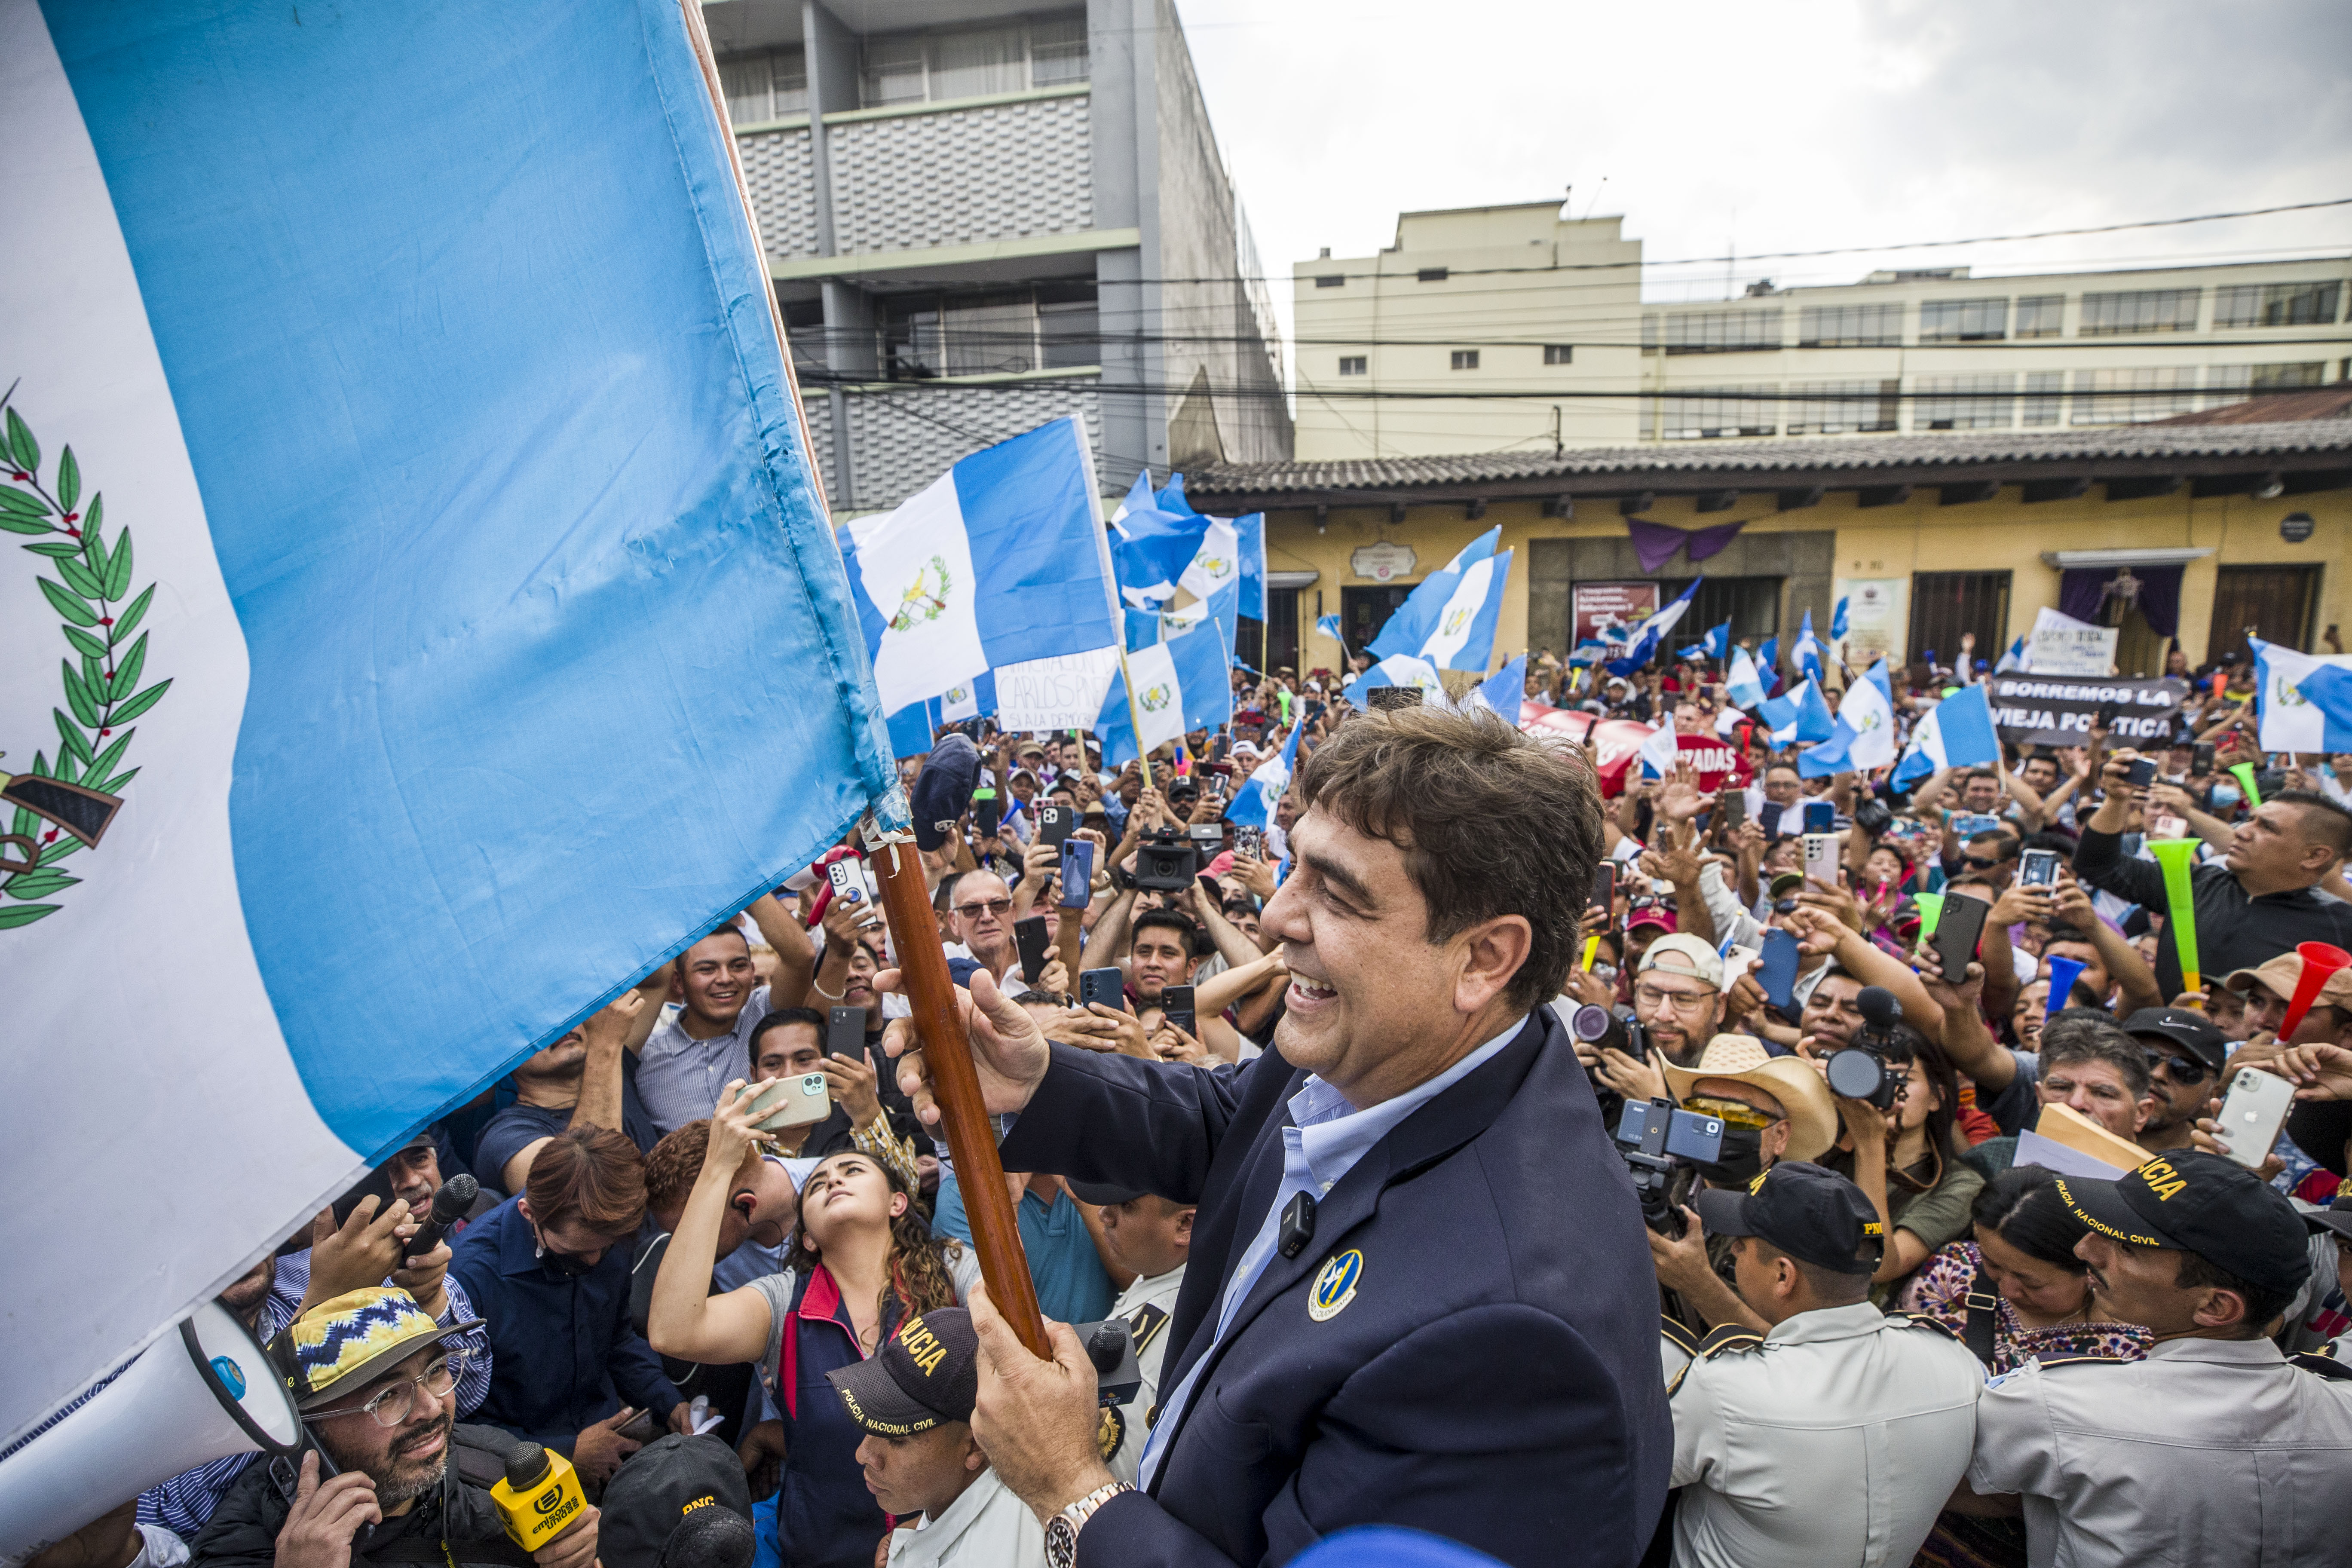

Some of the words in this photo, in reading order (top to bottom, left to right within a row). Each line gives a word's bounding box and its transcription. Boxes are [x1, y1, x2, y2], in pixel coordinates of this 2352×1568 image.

[999, 674, 1075, 709] CARLOS
[2000, 681, 2133, 704] BORREMOS
[2136, 689, 2171, 707] LA
[1993, 707, 2055, 730] VIEJA
[2060, 712, 2171, 738] POTICA
[1864, 1223, 1883, 1234] PN
[2055, 1180, 2075, 1207] POLICIA
[2074, 1209, 2127, 1240] NACIONAL
[2130, 1234, 2160, 1246] CIVIL
[1317, 1292, 1352, 1318] CIUDADANA
[842, 1389, 865, 1423] POLICIA
[866, 1419, 911, 1435] NACIONAL
[913, 1418, 936, 1431] CIVIL
[533, 1496, 577, 1534] emisoras
[546, 1503, 579, 1530] unidas
